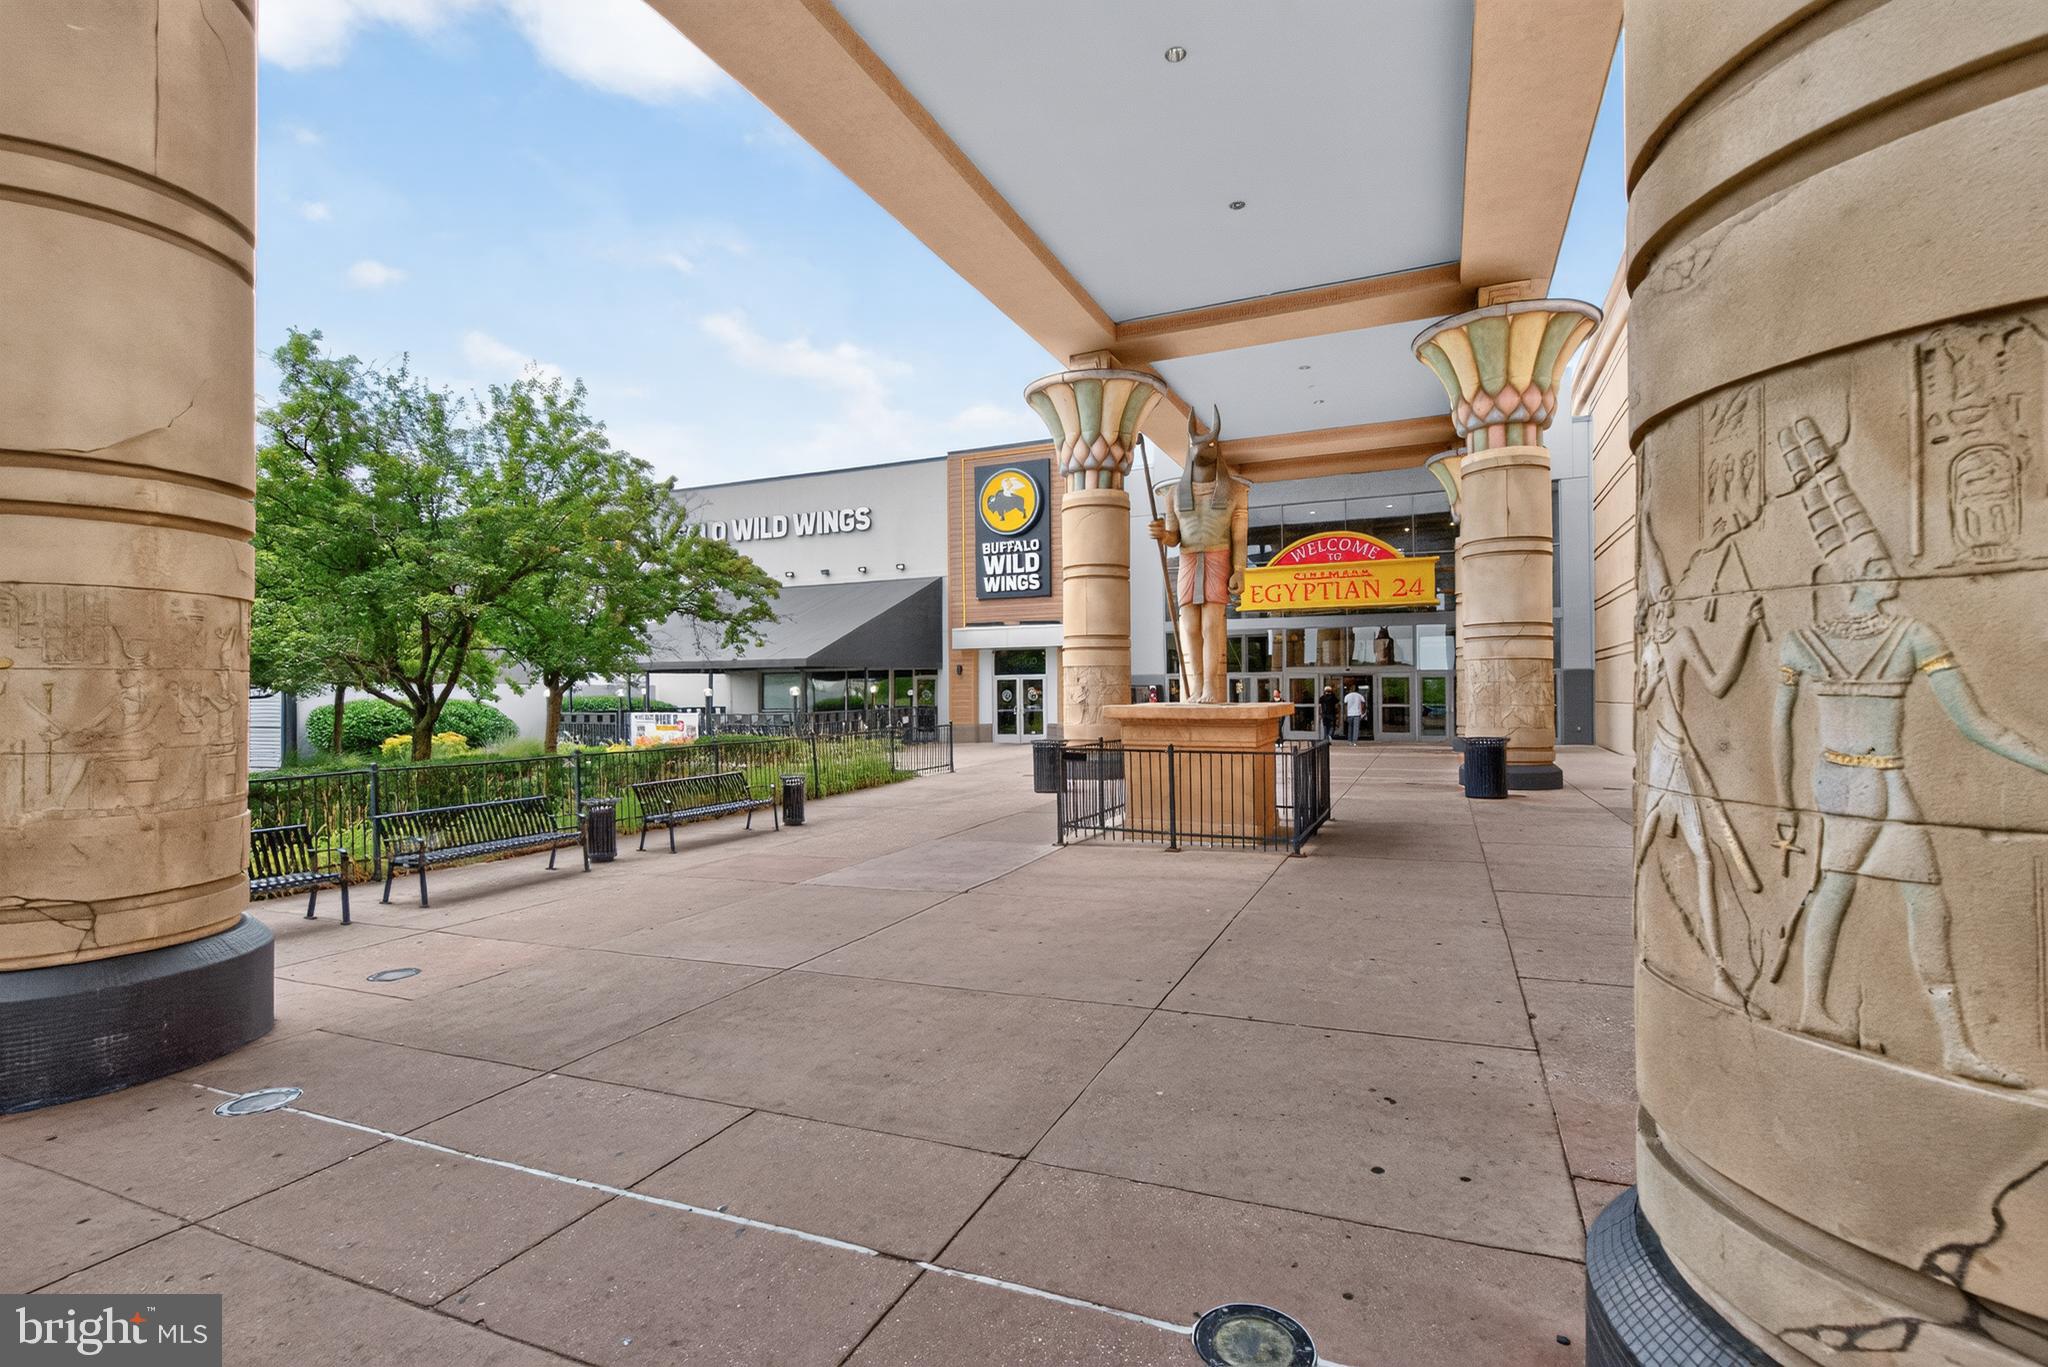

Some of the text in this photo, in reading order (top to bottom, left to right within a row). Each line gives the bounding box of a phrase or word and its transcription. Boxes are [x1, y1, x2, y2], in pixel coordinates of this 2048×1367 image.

[732, 515, 788, 541] WILD
[793, 507, 872, 536] WINGS
[982, 539, 1040, 554] BUFFALO
[1290, 538, 1380, 562] WELCOME
[1327, 552, 1342, 561] TO
[983, 552, 1040, 575] WILD
[983, 573, 1040, 593] WINGS
[1251, 577, 1424, 604] EGYPTIAN 24
